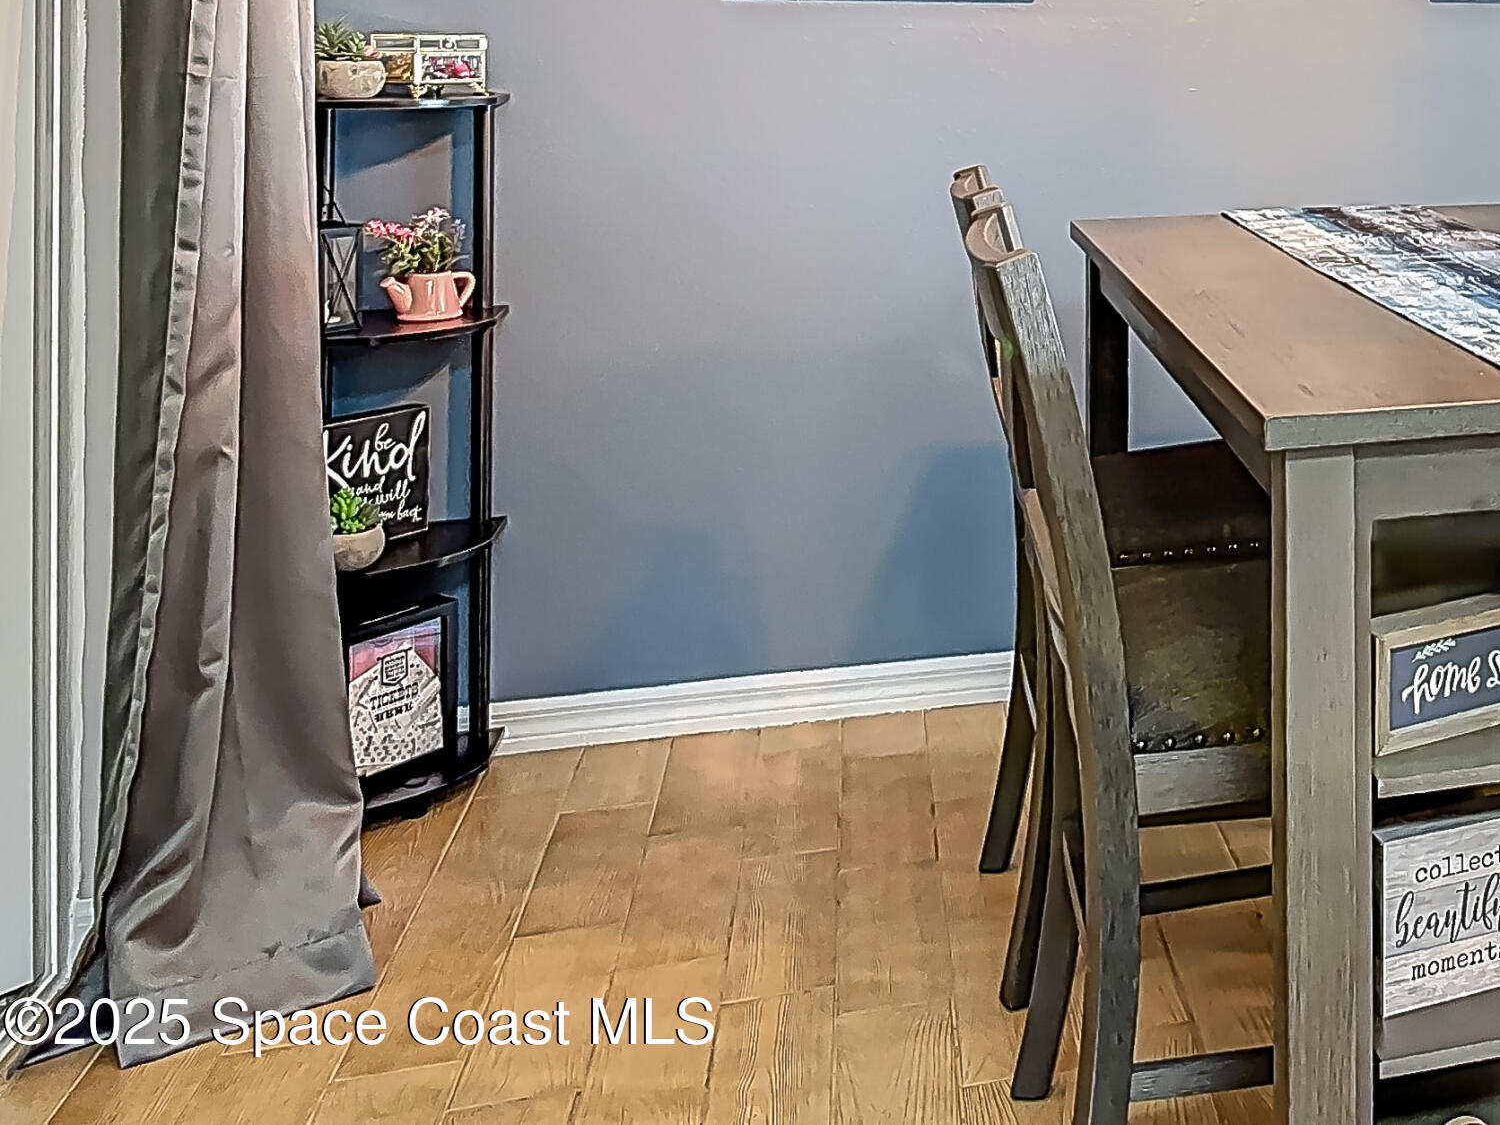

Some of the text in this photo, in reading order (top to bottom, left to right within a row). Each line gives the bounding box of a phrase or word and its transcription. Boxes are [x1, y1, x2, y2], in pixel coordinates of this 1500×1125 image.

[374, 422, 396, 451] be
[375, 478, 411, 505] will
[1401, 657, 1481, 715] home
